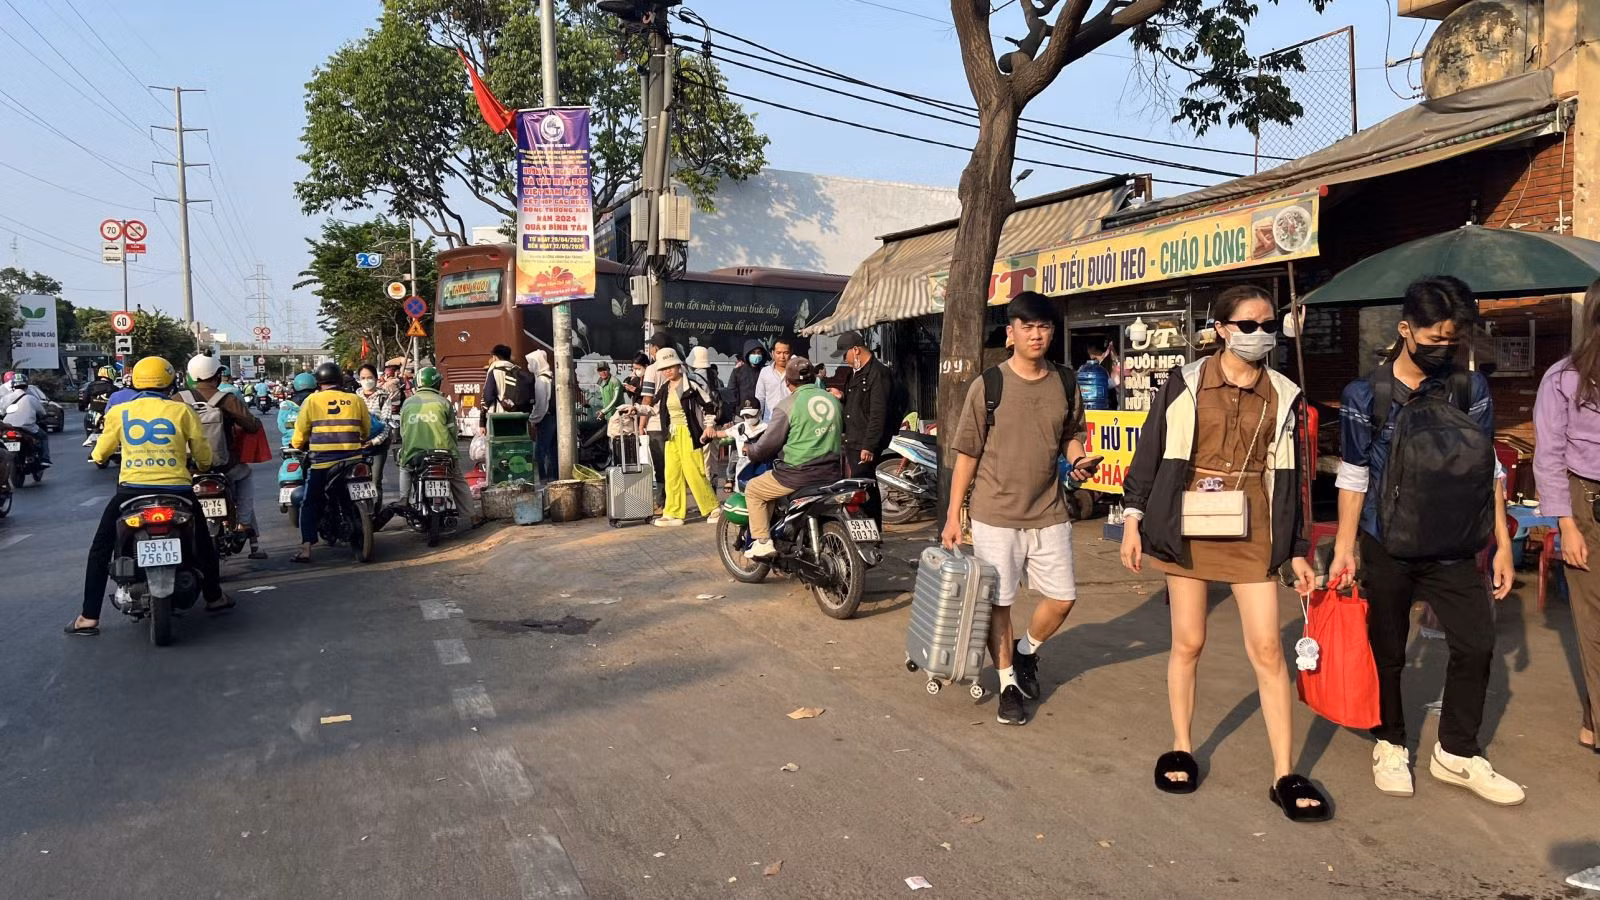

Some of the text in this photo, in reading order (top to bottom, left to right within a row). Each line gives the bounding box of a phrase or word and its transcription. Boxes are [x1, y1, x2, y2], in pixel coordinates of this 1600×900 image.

[1042, 254, 1057, 293] HỦ
[1060, 250, 1084, 290] TIẾU
[1087, 247, 1117, 286] ĐUÔI
[1120, 247, 1146, 281] HEO
[1160, 231, 1199, 275] CHÁO
[1203, 223, 1246, 268] LÒNG
[117, 317, 127, 326] 60
[696, 320, 718, 335] ngày
[1158, 354, 1185, 369] HEO
[122, 409, 177, 446] be
[1101, 417, 1121, 451] HỦ
[851, 520, 873, 529] 59-K1
[144, 541, 173, 553] 59-K1
[141, 552, 179, 565] 756.05
